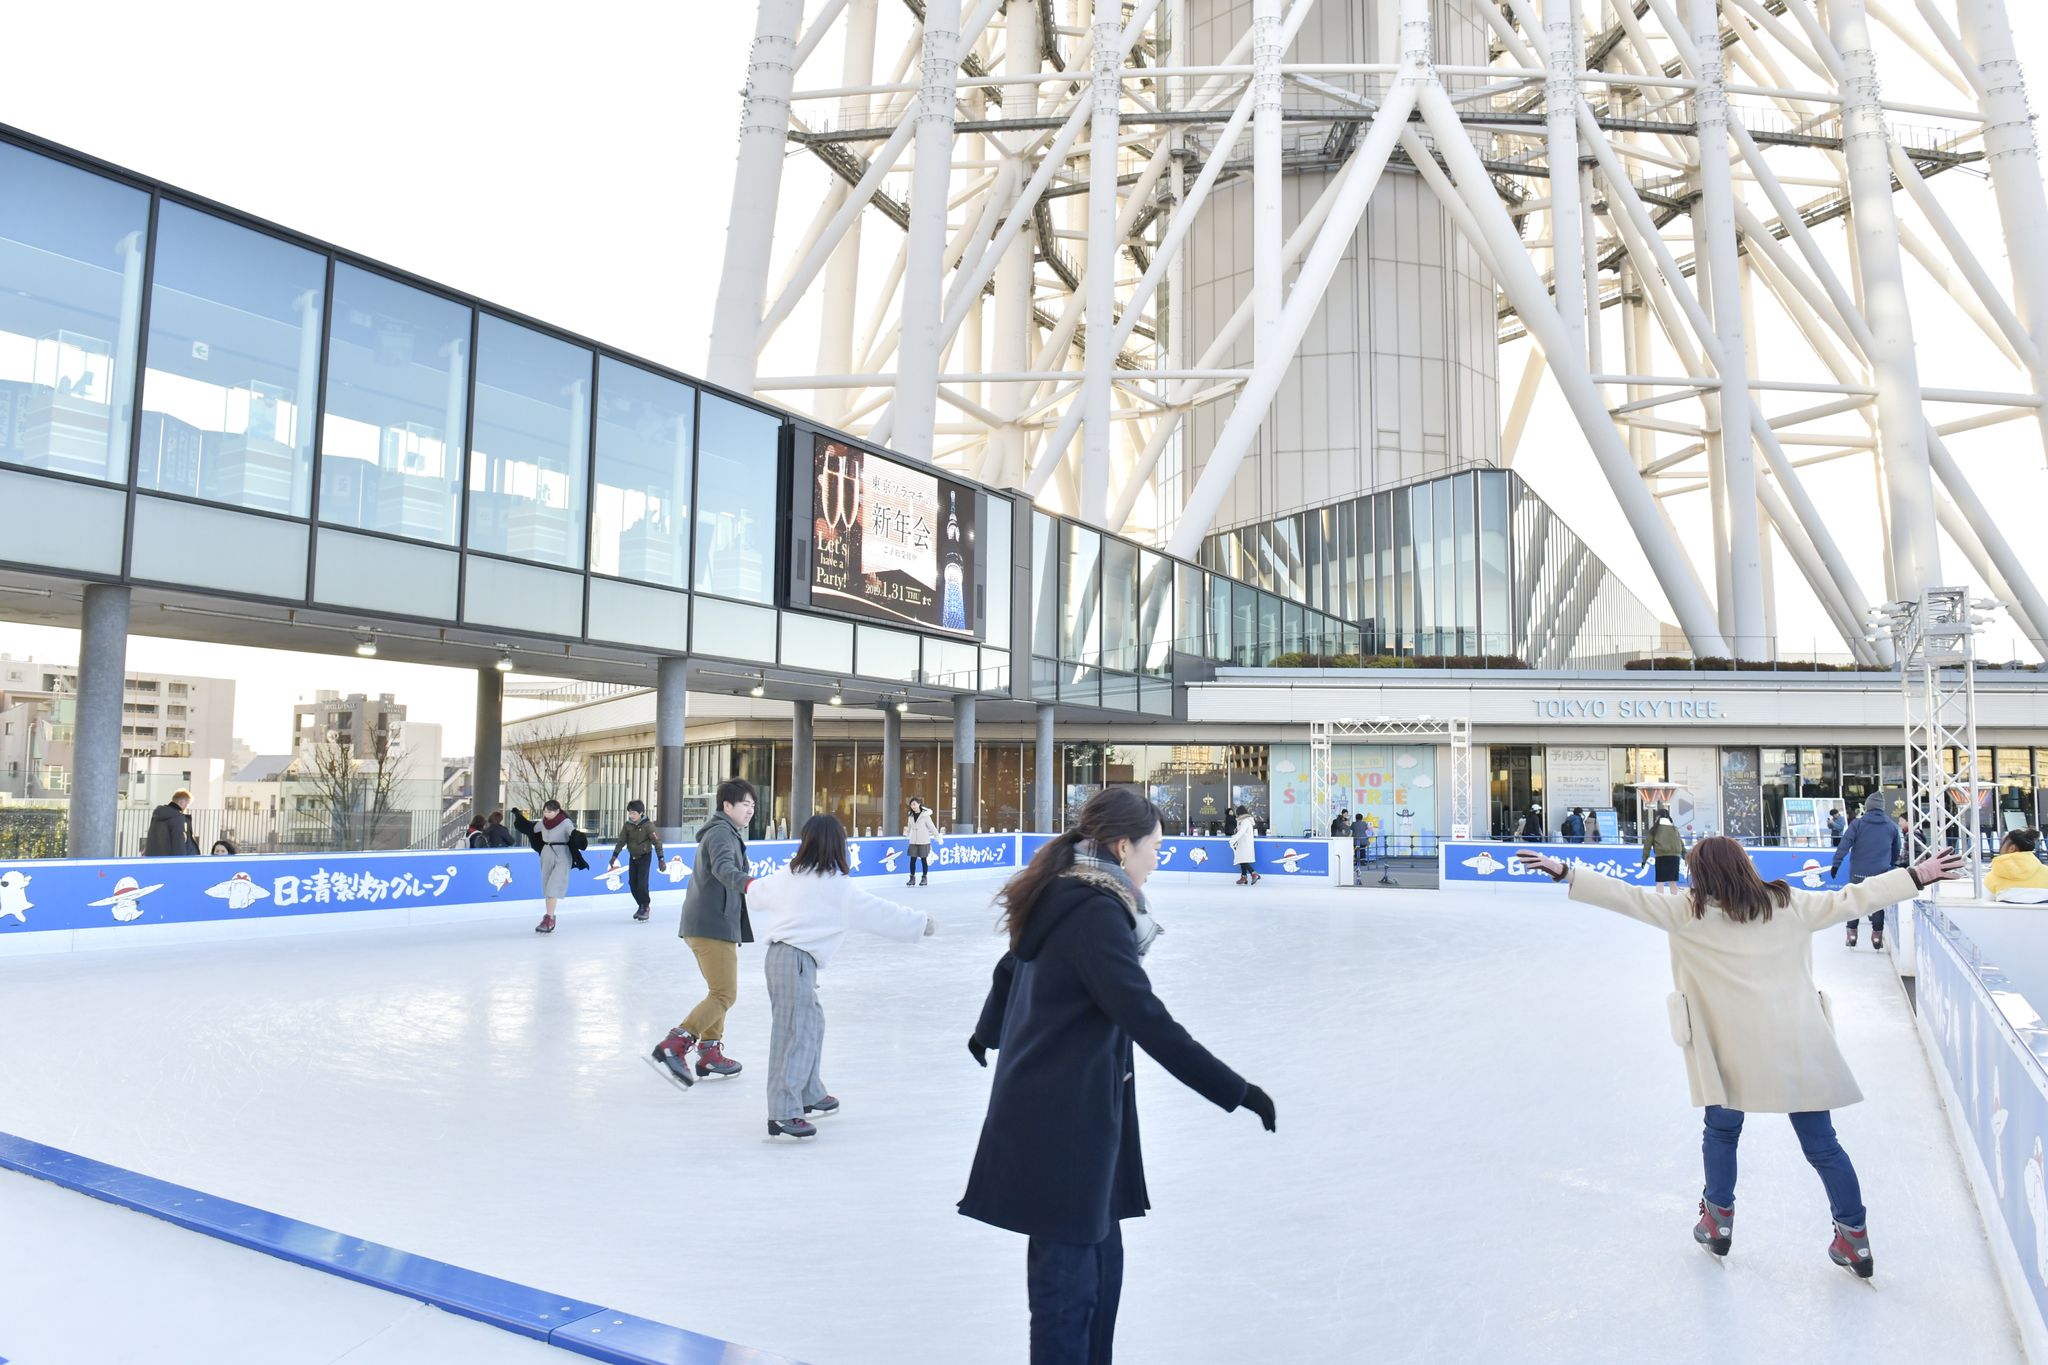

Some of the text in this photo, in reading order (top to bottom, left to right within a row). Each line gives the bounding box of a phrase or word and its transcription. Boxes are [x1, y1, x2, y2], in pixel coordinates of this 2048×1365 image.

[872, 502, 930, 550] 新年会
[817, 530, 848, 556] Let's
[820, 552, 844, 569] have a
[816, 566, 847, 590] Party!
[907, 591, 920, 600] THU
[1533, 699, 1608, 719] TOKYO
[940, 843, 1007, 866] 日清製粉グループ
[273, 866, 457, 906] 日清製粉グループ
